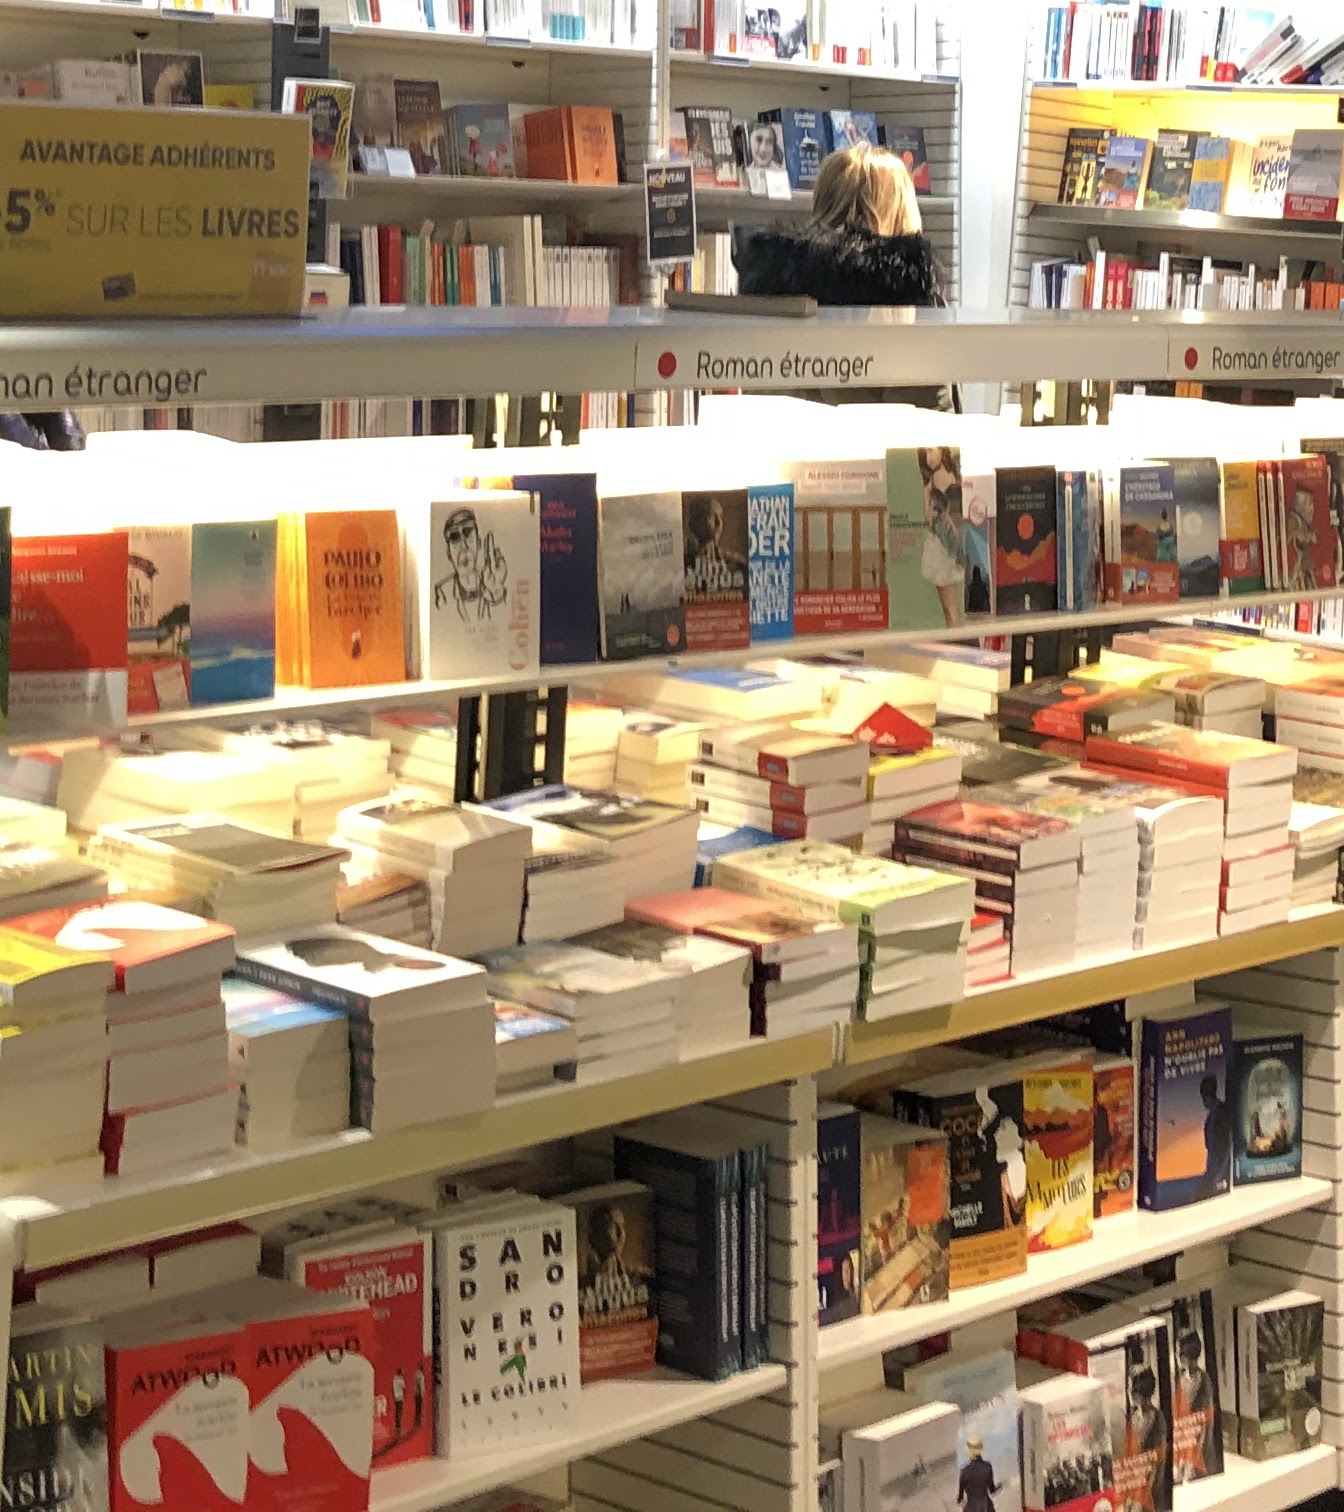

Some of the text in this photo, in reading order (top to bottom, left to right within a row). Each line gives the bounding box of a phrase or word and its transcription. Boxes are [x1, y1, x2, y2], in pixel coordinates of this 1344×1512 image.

[20, 140, 276, 171] AVANTAGE ADHÉRENTS
[66, 203, 128, 236] SUR
[139, 205, 193, 238] LES
[201, 206, 301, 239] LIVRES
[696, 349, 874, 384] Roman étranger
[1212, 344, 1341, 375] Roman étranger
[63, 362, 208, 402] étranger
[748, 496, 790, 514] ATHAN
[11, 568, 85, 586] aisse-moi
[8, 1344, 94, 1383] ARTIN
[13, 1377, 93, 1430] MIS
